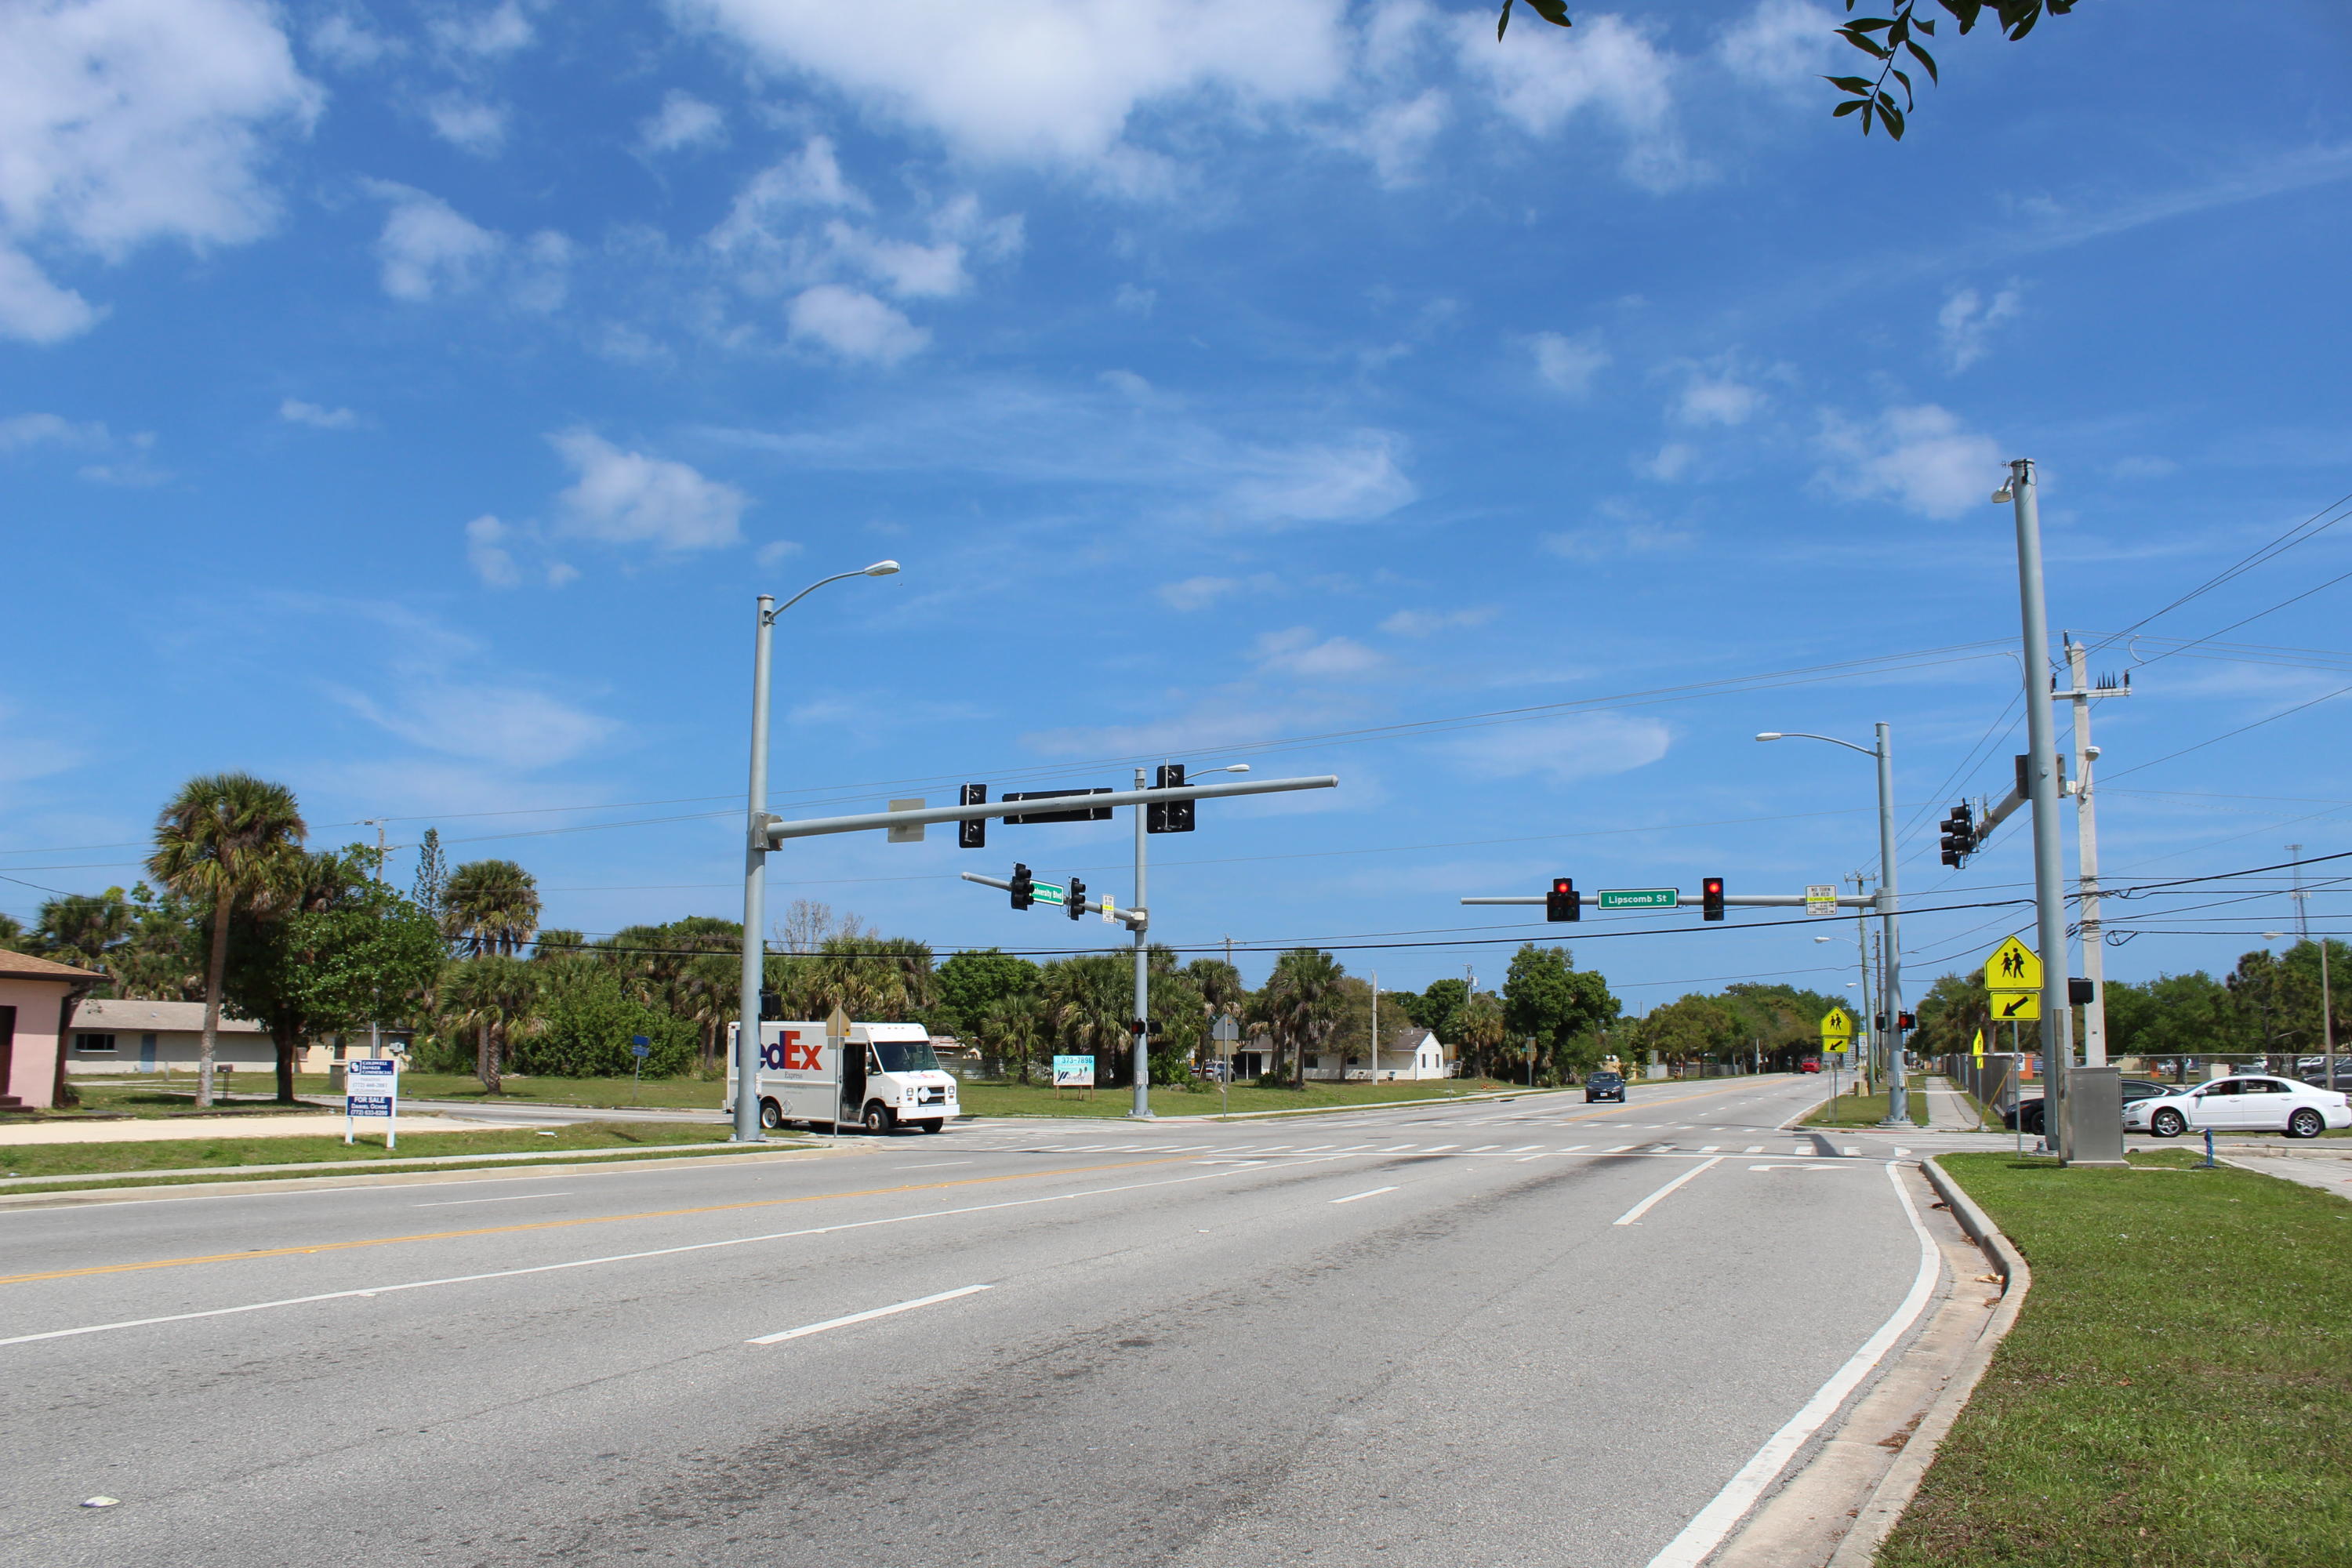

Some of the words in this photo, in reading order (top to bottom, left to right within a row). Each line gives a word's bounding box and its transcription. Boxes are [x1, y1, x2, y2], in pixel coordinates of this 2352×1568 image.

[1033, 887, 1053, 899] niversity
[1053, 891, 1062, 900] Blvd
[1609, 895, 1653, 905] Lipscomb
[736, 1030, 822, 1070] dEx
